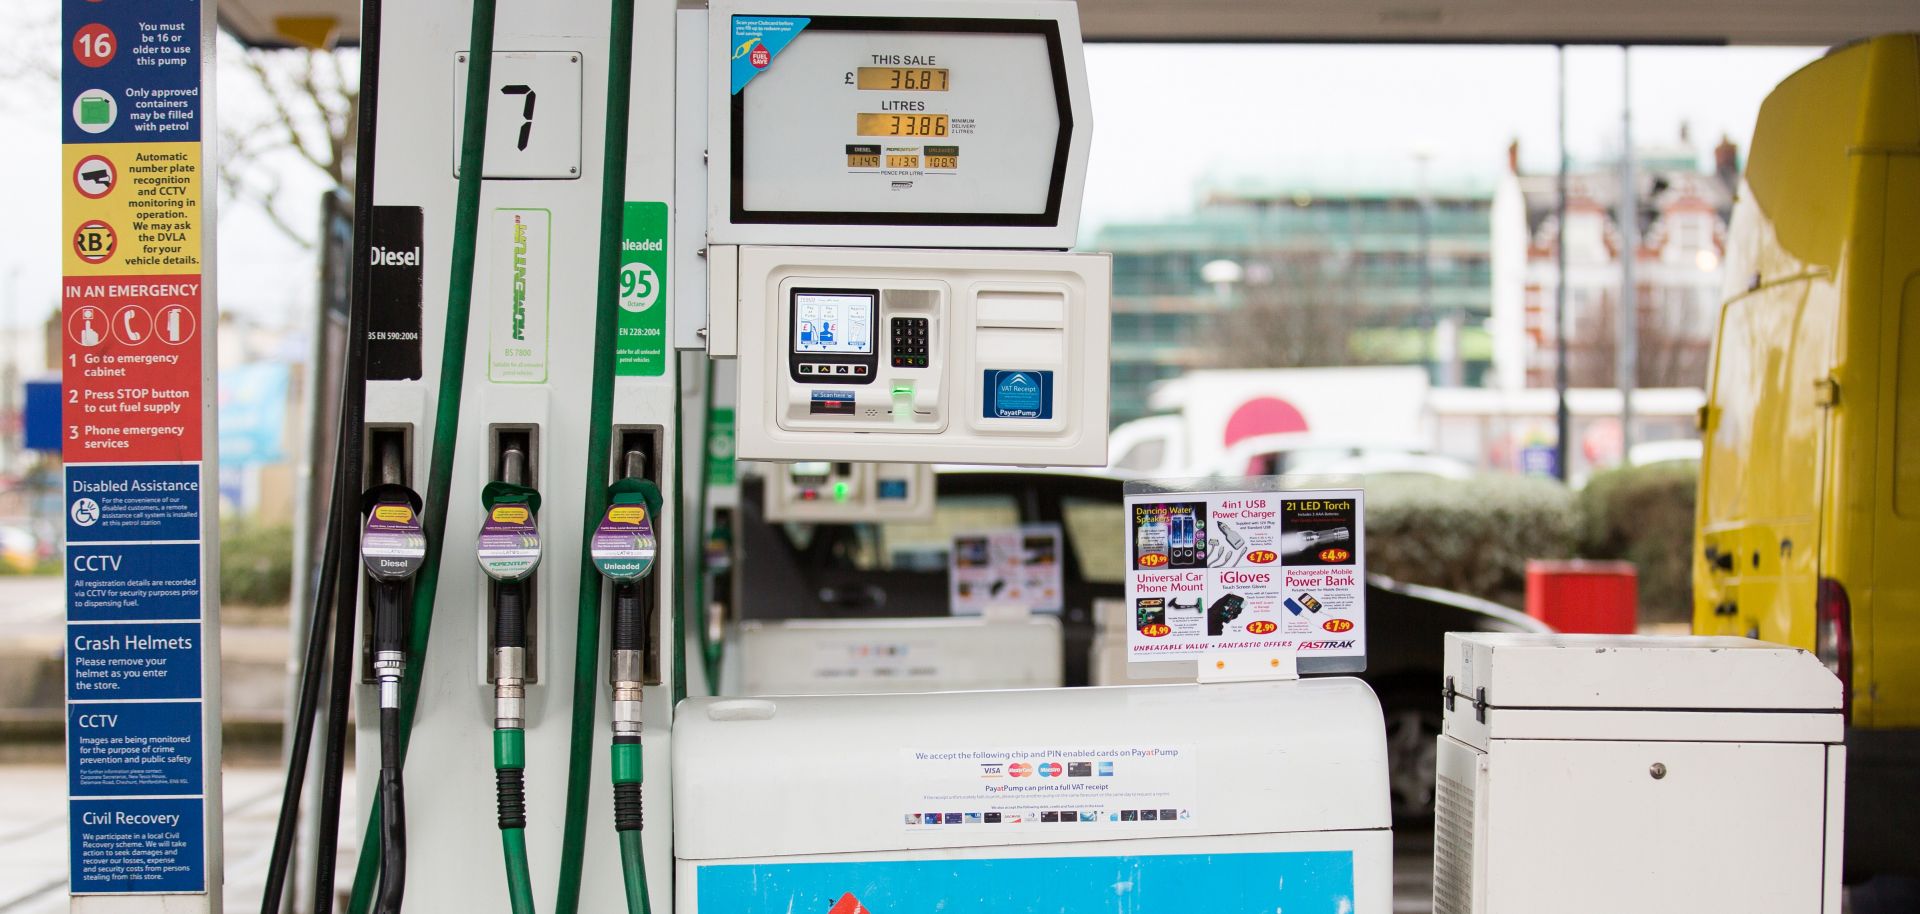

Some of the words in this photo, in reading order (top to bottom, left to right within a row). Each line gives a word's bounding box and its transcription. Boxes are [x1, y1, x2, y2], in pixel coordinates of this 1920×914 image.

[139, 23, 157, 31] You
[142, 34, 155, 42] be
[79, 34, 111, 57] 16
[137, 57, 155, 65] this
[158, 58, 187, 66] pump
[872, 55, 900, 64] THIS
[904, 56, 936, 65] SALE
[845, 72, 854, 84] £
[891, 70, 946, 89] 36.87
[126, 88, 149, 98] Only
[152, 88, 198, 98] approved
[136, 100, 187, 108] containers
[882, 101, 925, 111] LITRES
[131, 113, 151, 121] may
[168, 111, 193, 119] filled
[501, 85, 536, 151] 7
[135, 123, 156, 131] with
[159, 122, 189, 132] petrol
[890, 116, 945, 135] 33.86
[136, 153, 187, 161] Automatic
[170, 164, 195, 173] plate
[134, 176, 190, 185] recognition
[159, 187, 186, 195] CCTV
[129, 199, 183, 208] monitoring
[137, 211, 187, 220] operation.
[133, 222, 148, 230] We
[151, 223, 171, 231] may
[174, 221, 191, 229] ask
[158, 233, 186, 241] DVLA
[143, 245, 157, 253] for
[159, 246, 181, 255] your
[622, 239, 662, 251] nleaded
[125, 256, 160, 265] vehicle
[166, 256, 199, 264] details.
[371, 247, 419, 265] Diesel
[620, 270, 651, 298] 95
[66, 286, 80, 297] IN
[84, 286, 104, 297] AN
[109, 284, 198, 296] EMERGENCY
[69, 354, 76, 367] 1
[84, 354, 100, 363] Go
[103, 355, 114, 363] to
[117, 355, 178, 364] emergency
[84, 367, 125, 376] cabinet
[69, 390, 78, 403] 2
[84, 390, 114, 399] Press
[117, 389, 148, 398] STOP
[152, 389, 189, 398] button
[85, 404, 96, 412] to
[99, 403, 116, 412] cut
[120, 403, 140, 411] fuel
[144, 403, 180, 413] supply
[69, 426, 79, 439] 3
[85, 426, 120, 435] Phone
[123, 426, 184, 436] emergency
[85, 440, 129, 448] services
[73, 480, 128, 492] Disabled
[131, 480, 198, 491] Assistance
[1222, 500, 1241, 508] 4in1
[1246, 500, 1266, 508] USB
[1301, 502, 1320, 510] LED
[1323, 501, 1349, 510] Torch
[1136, 515, 1170, 523] Speakers
[1242, 511, 1275, 519] Charger
[1141, 555, 1167, 564] £19.99
[1250, 550, 1273, 562] £7.99
[1322, 550, 1346, 560] £4.99
[74, 556, 122, 571] CCTV
[1138, 574, 1182, 583] Universal
[1186, 573, 1203, 581] Car
[1220, 572, 1270, 583] iGloves
[1286, 577, 1321, 586] Power
[1326, 576, 1354, 585] Bank
[1137, 583, 1167, 592] Phone
[1143, 625, 1168, 636] £4.99
[1250, 621, 1274, 633] £2.99
[1326, 620, 1349, 631] £7.99
[75, 636, 119, 650] Crash
[126, 635, 192, 649] Helmets
[76, 658, 105, 666] Please
[146, 658, 166, 667] your
[76, 669, 108, 677] helmet
[124, 671, 140, 679] you
[79, 715, 118, 727] CCTV
[916, 752, 928, 760] We
[973, 752, 1010, 760] following
[1132, 749, 1178, 757] PayatPump
[83, 812, 111, 824] Civil
[116, 812, 179, 826] Recovery
